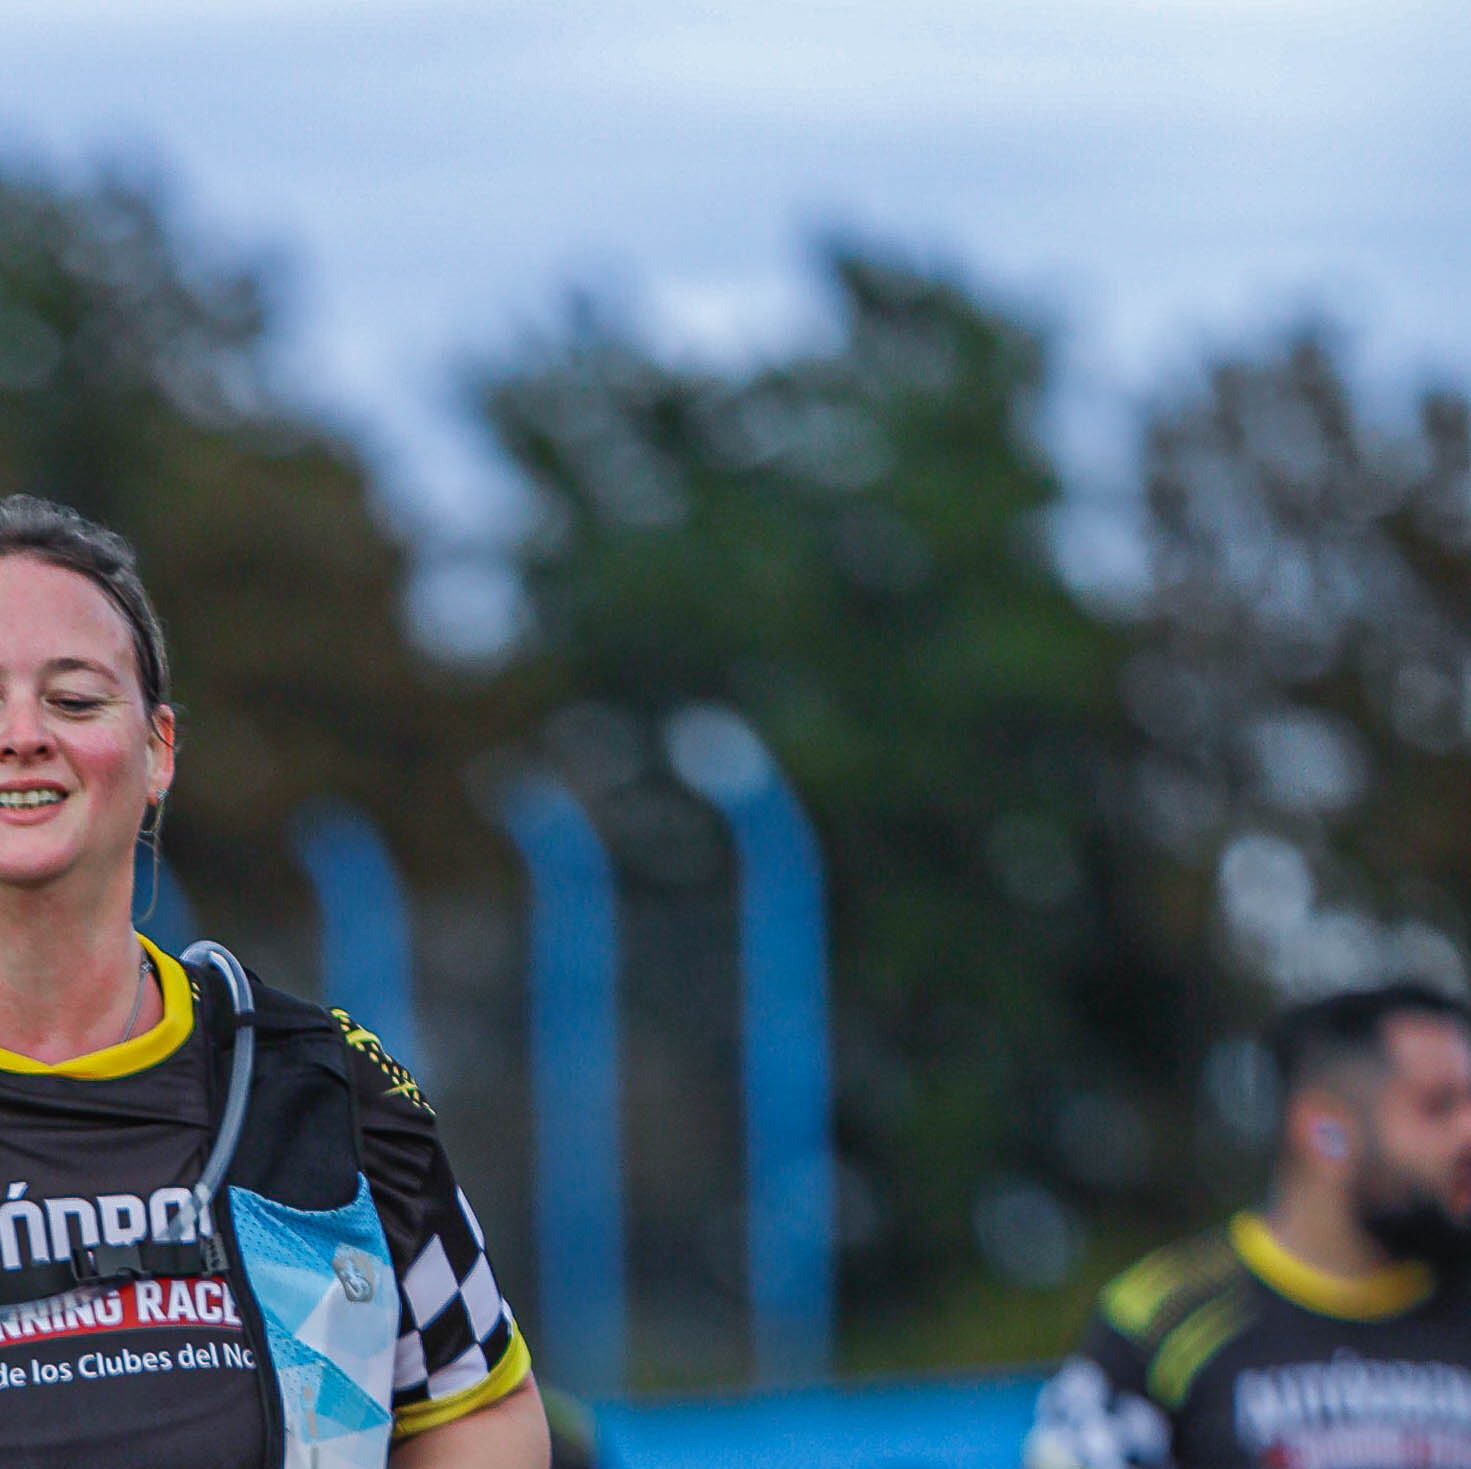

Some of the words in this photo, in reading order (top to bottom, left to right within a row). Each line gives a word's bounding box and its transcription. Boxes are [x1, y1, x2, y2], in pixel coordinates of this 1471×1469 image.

[31, 1358, 74, 1385] los
[78, 1348, 173, 1380] Clubes
[177, 1341, 220, 1369] del
